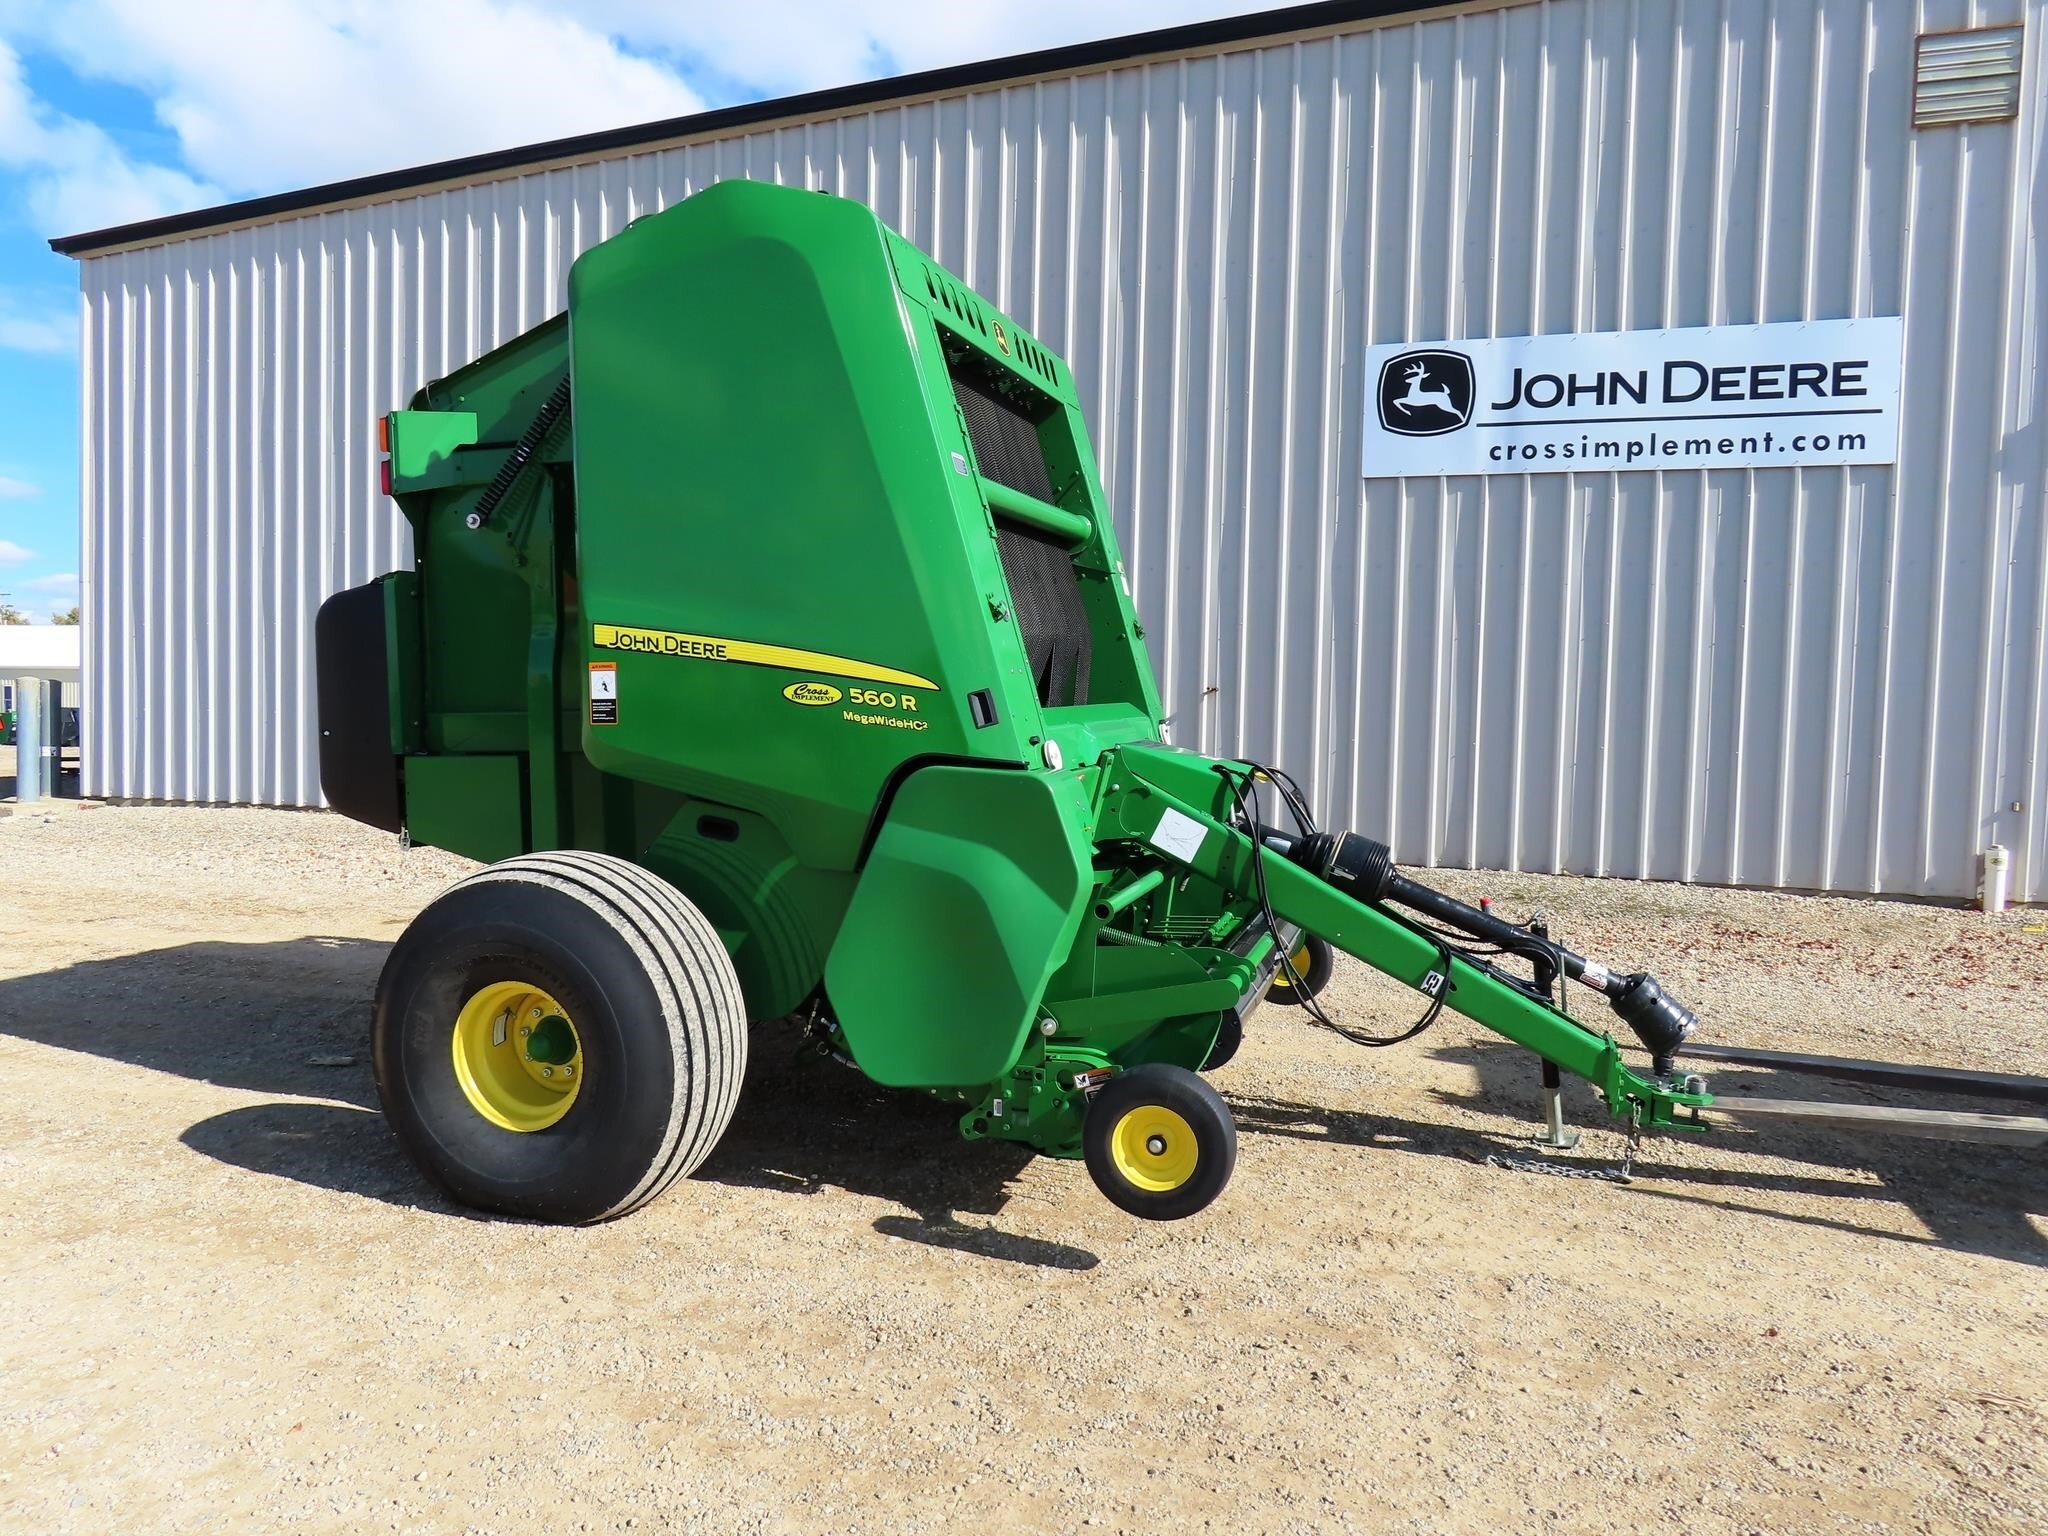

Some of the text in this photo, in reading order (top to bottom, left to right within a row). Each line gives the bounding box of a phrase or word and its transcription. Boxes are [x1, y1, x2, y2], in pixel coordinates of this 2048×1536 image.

[1491, 361, 1869, 411] JOHN DEERE
[1489, 432, 1866, 463] crossimplement.com
[609, 630, 728, 659] JOHN DEERE
[791, 693, 835, 702] IMPLEMENT
[793, 684, 830, 696] Cross
[849, 687, 918, 711] 560 R
